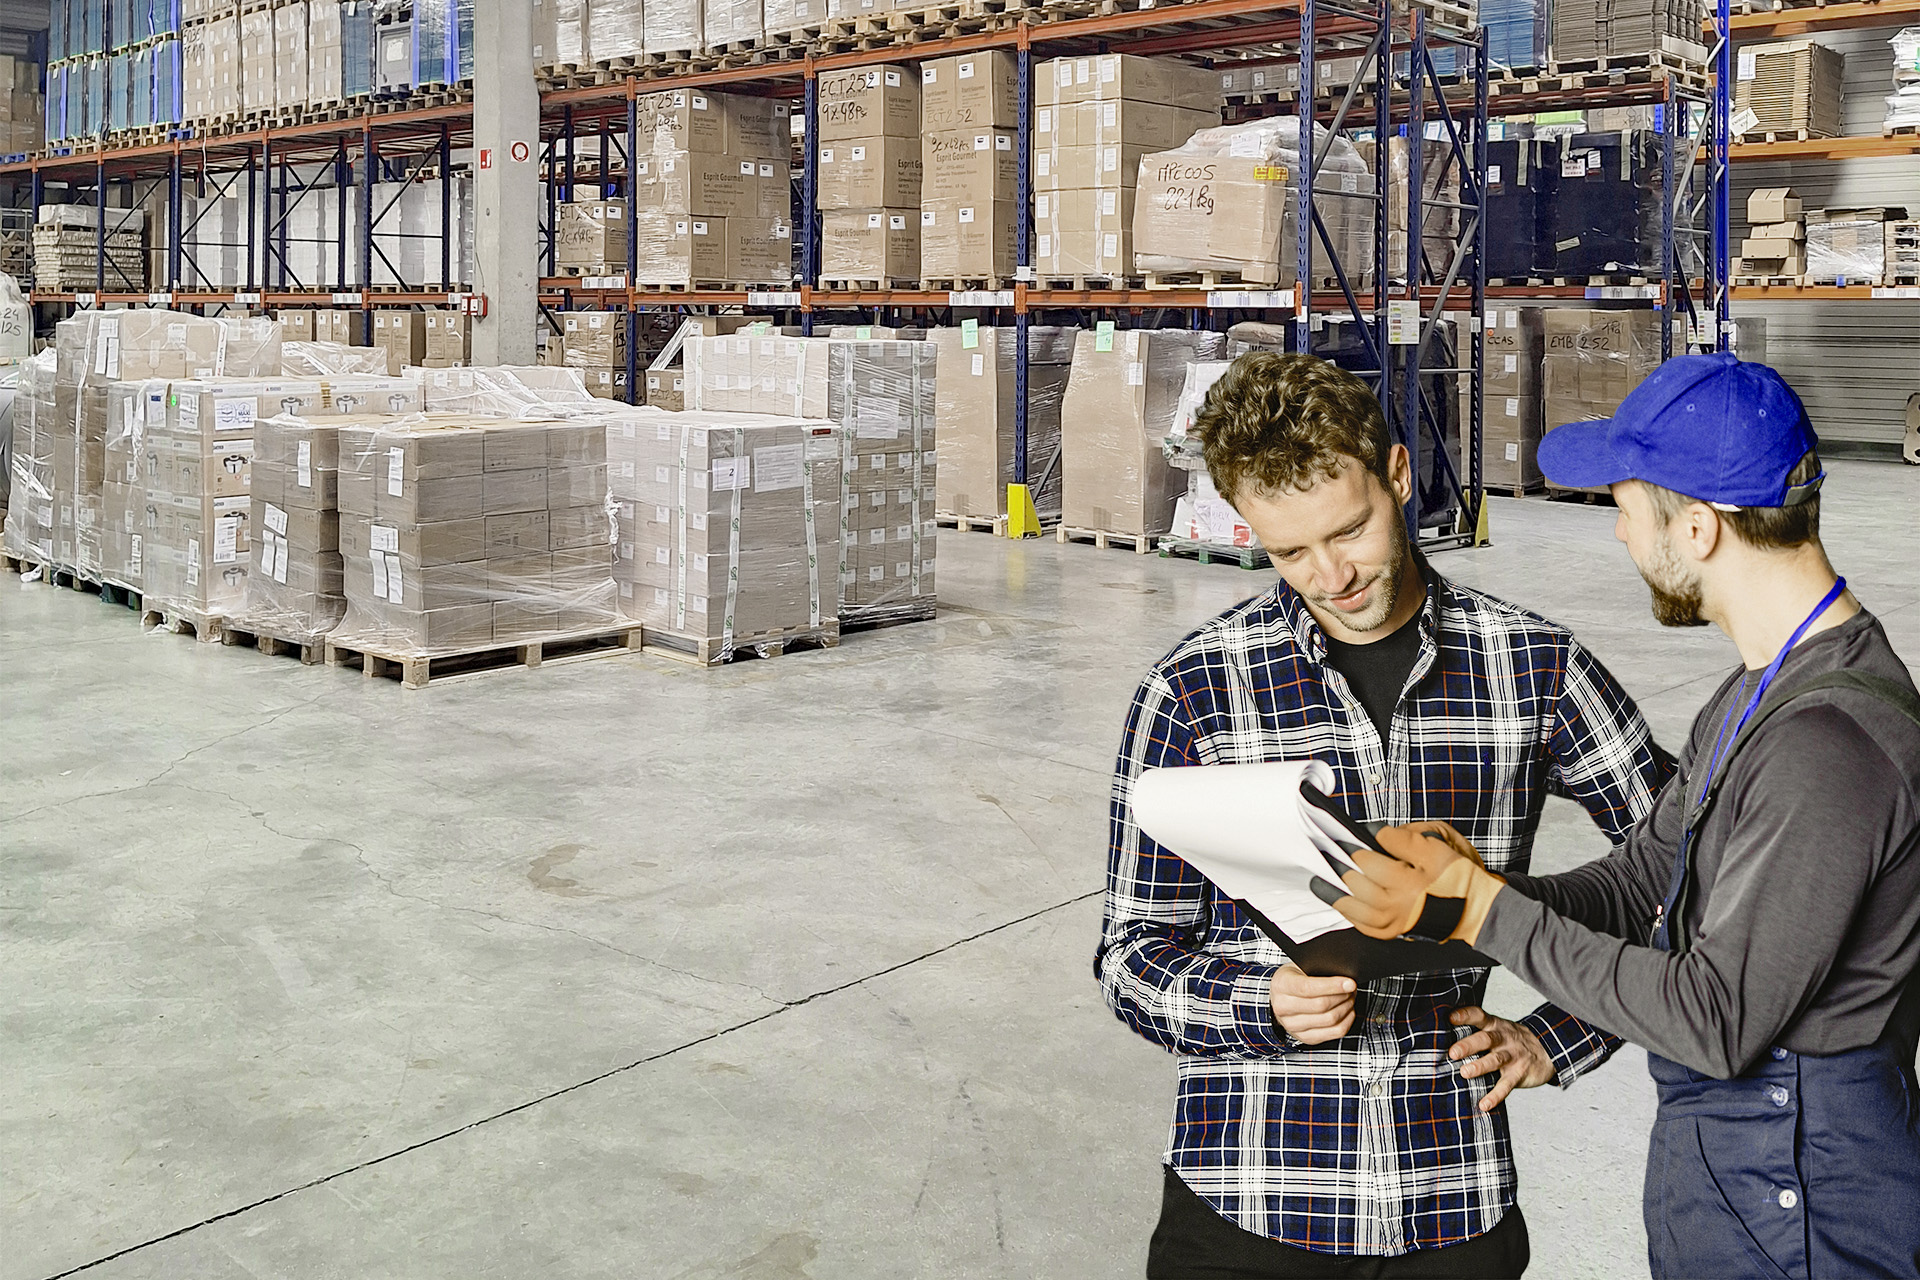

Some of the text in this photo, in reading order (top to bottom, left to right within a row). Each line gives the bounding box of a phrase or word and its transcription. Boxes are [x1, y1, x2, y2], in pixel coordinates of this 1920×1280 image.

[936, 151, 977, 163] Esprit Gourmet
[897, 159, 914, 169] Esprit
[703, 172, 744, 182] Esprit Gourmet
[834, 228, 871, 238] Esprit Gourmet
[728, 467, 735, 477] 2
